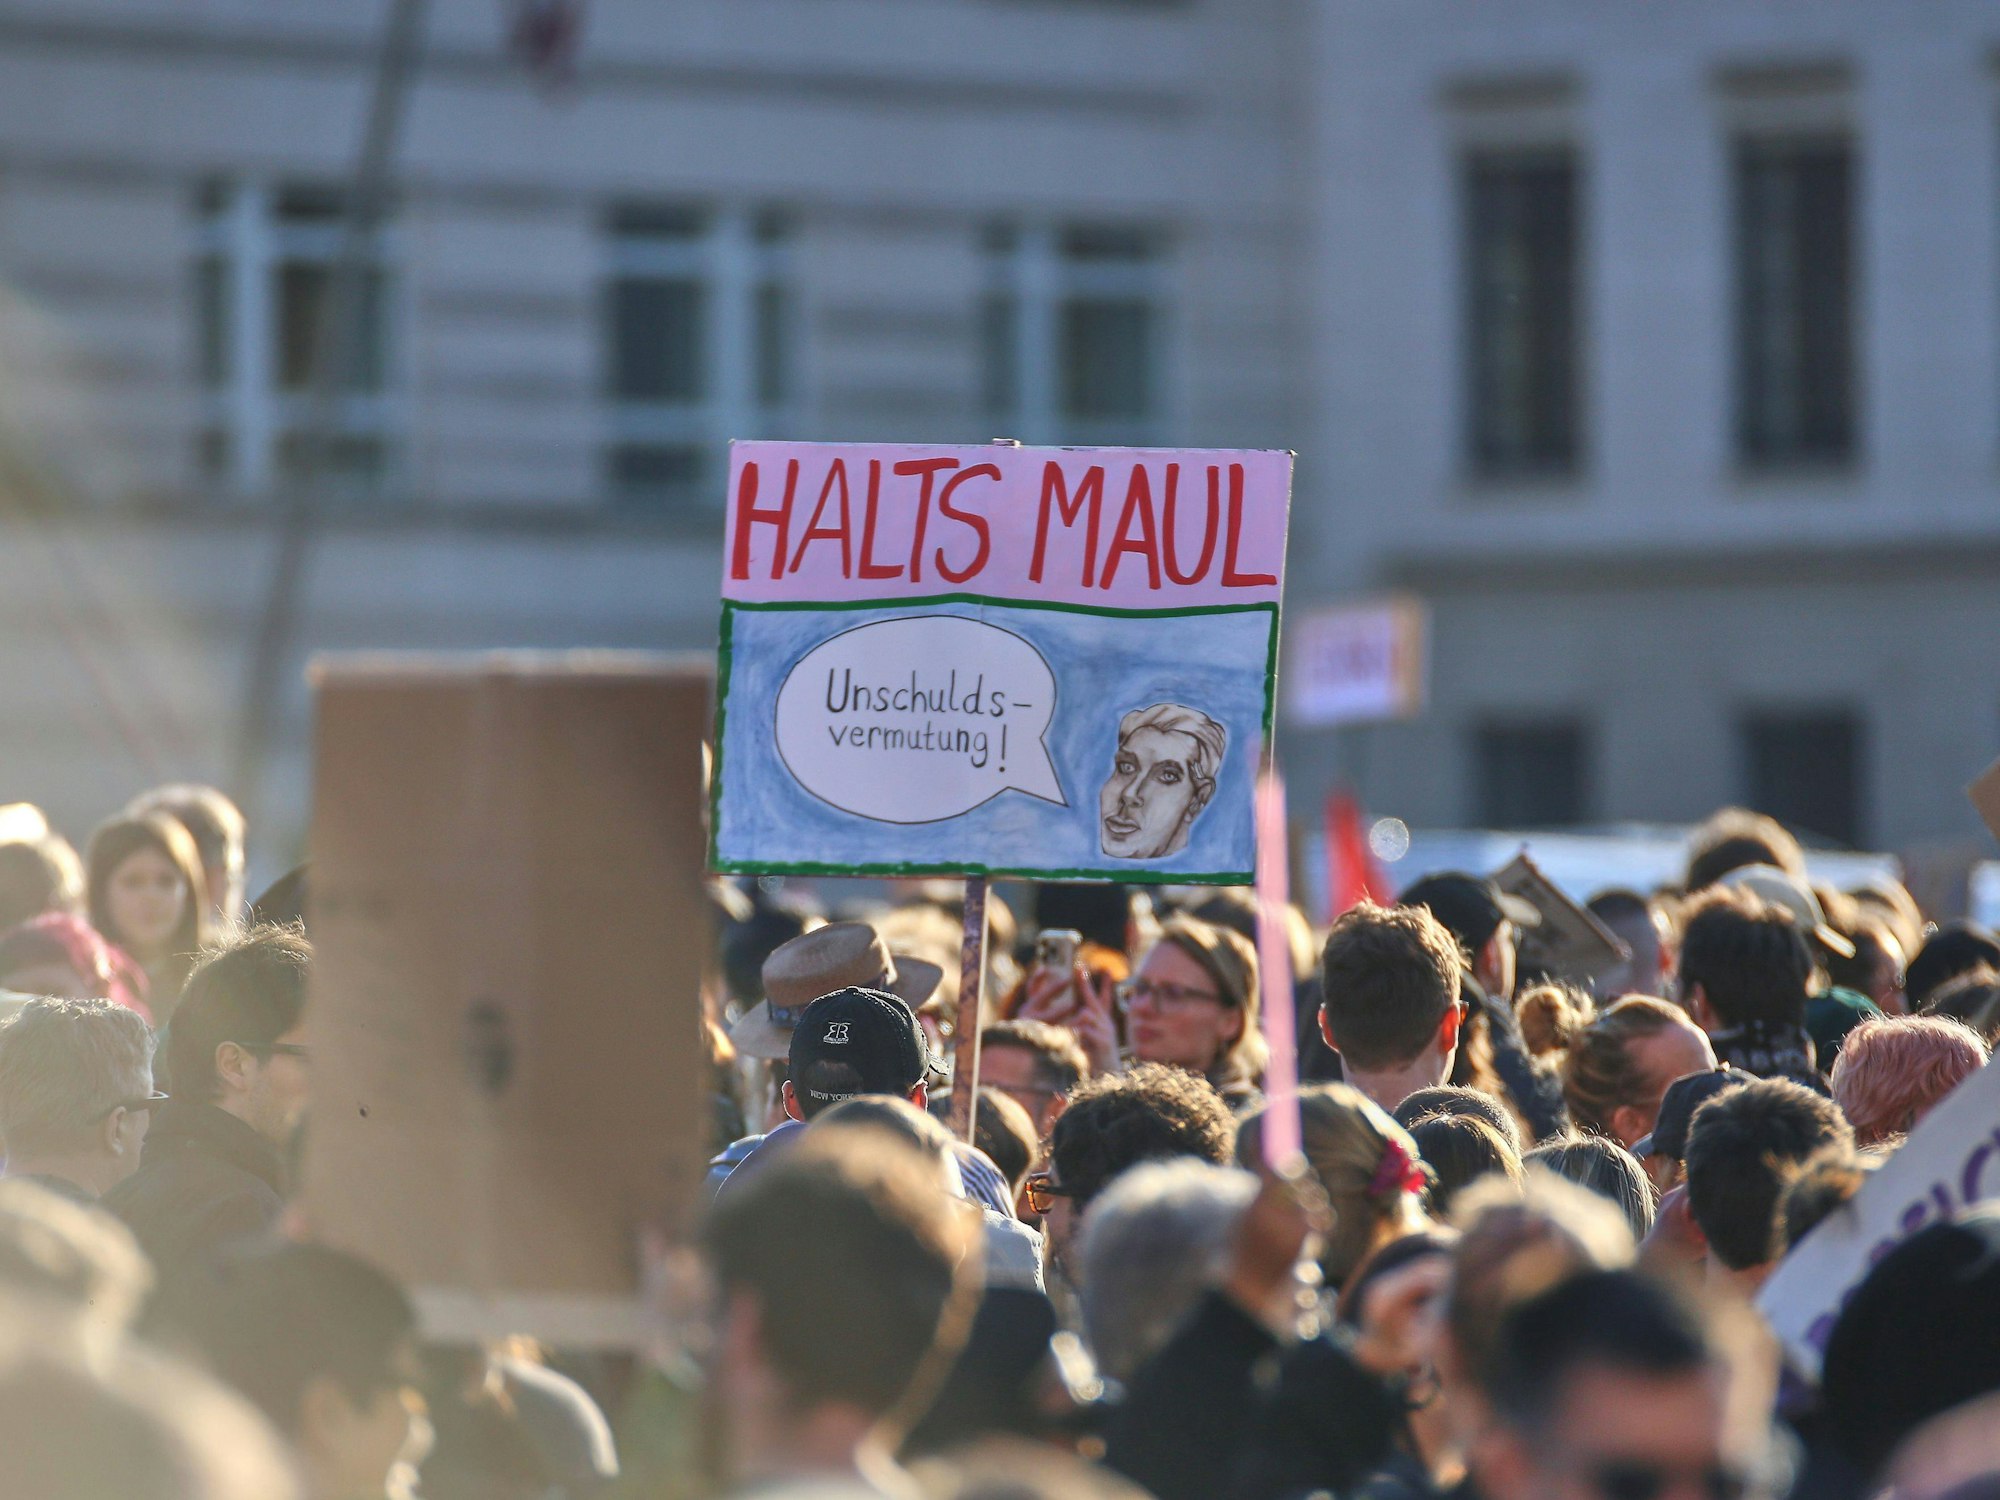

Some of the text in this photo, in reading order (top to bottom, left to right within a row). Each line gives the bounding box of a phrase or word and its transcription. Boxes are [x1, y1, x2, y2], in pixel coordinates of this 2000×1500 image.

[731, 457, 1278, 590] HALTS MAUL
[827, 668, 1032, 717] Unschulds-
[829, 721, 1007, 773] vermutung!
[810, 1089, 829, 1100] NEW
